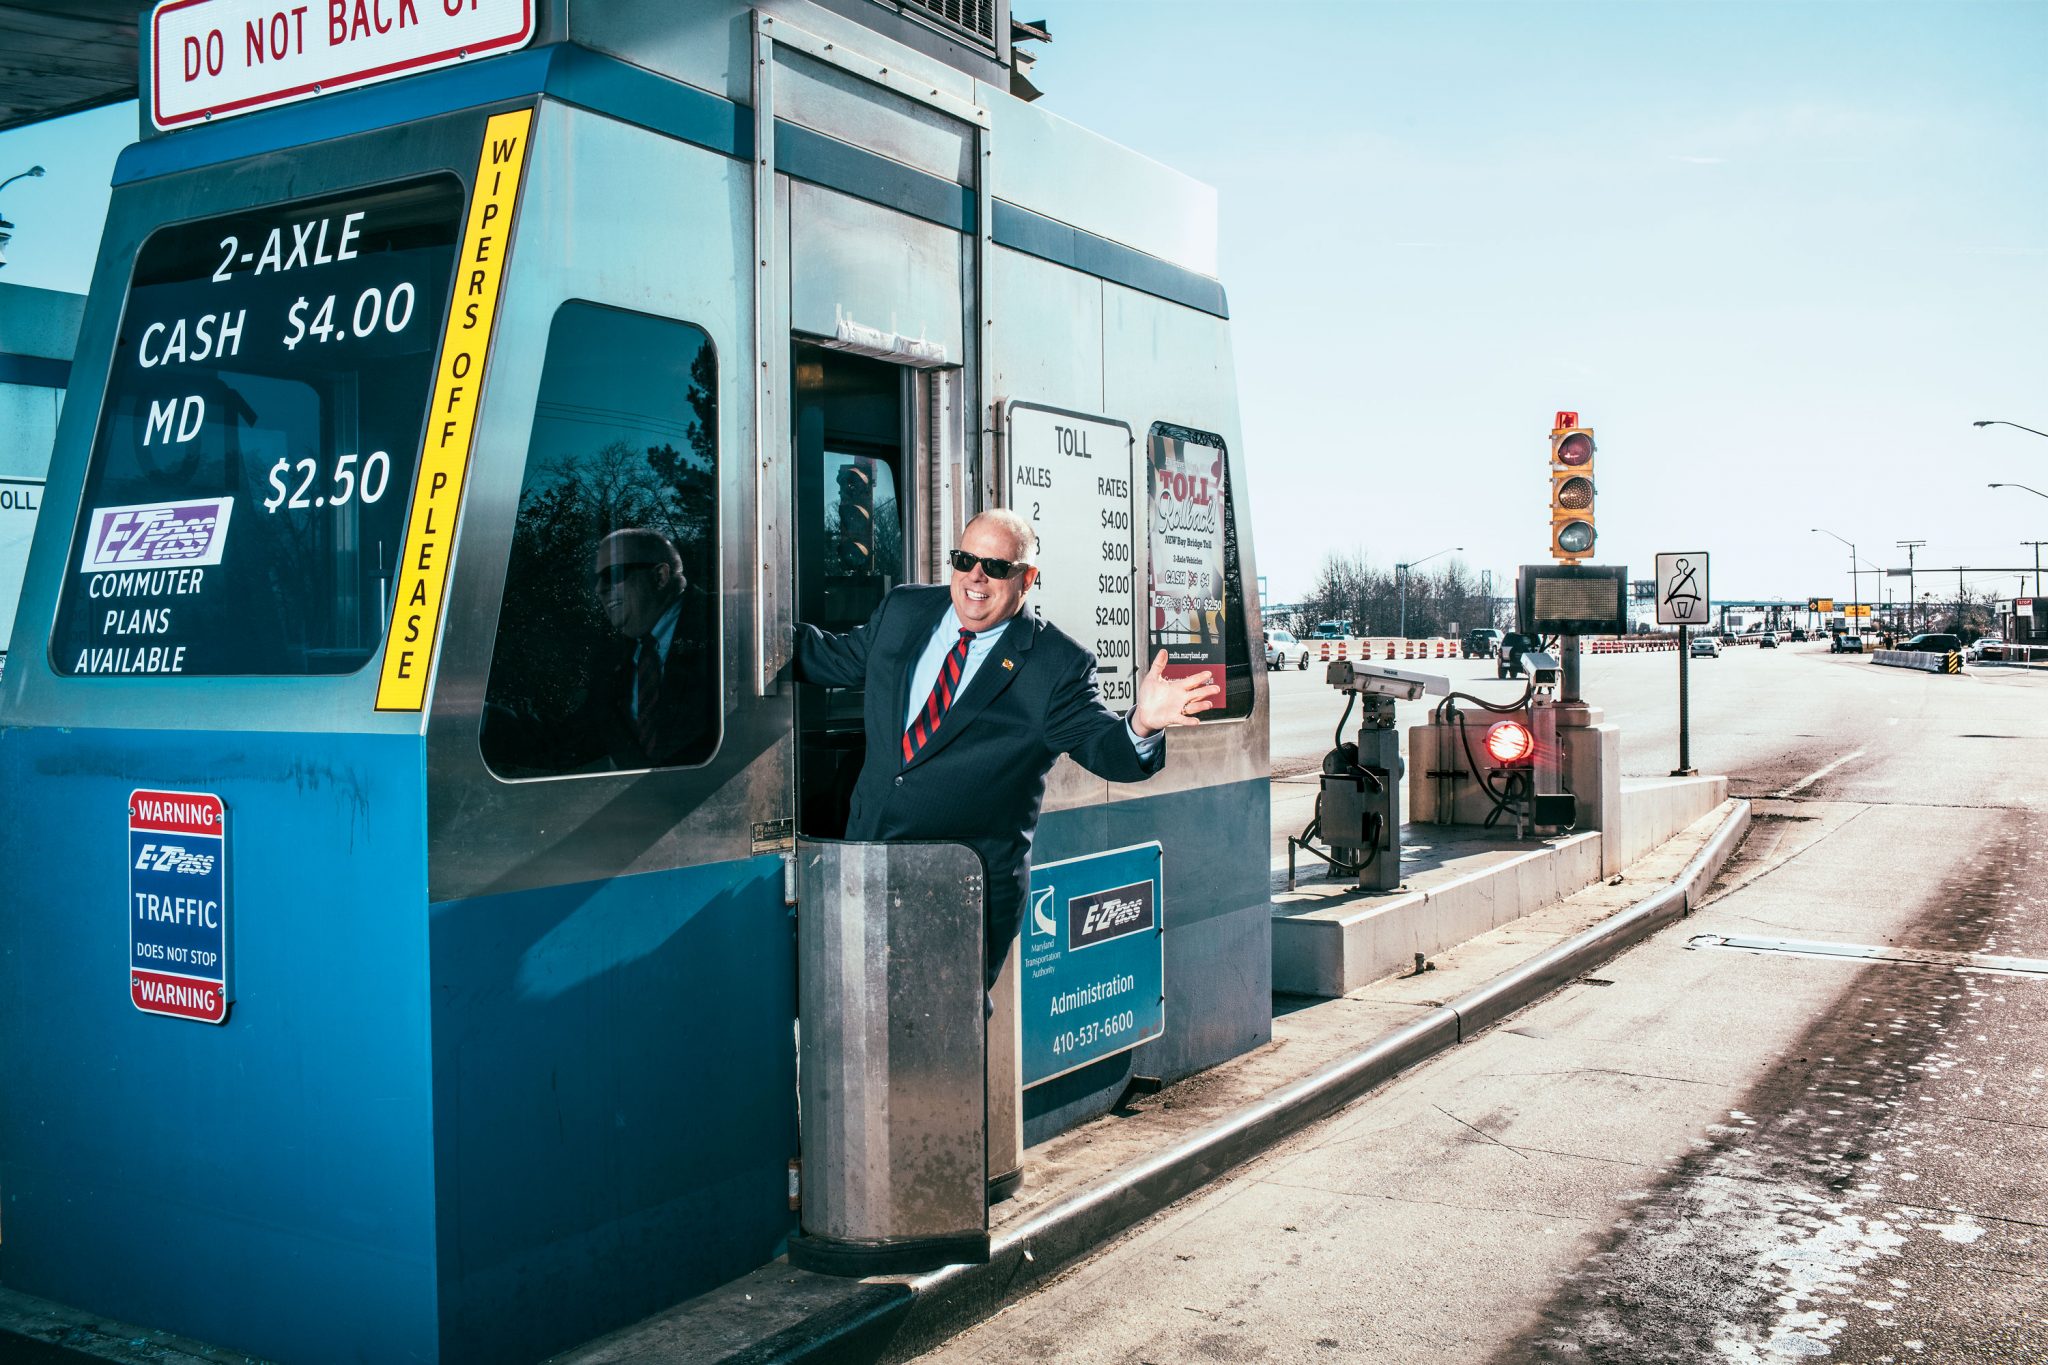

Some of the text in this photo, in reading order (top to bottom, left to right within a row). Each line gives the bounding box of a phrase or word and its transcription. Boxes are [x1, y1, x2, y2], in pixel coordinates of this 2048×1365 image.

[184, 0, 418, 82] DO NOT BACK
[212, 212, 365, 283] 2-AXLE
[139, 282, 415, 368] CASH $4.00
[143, 396, 205, 446] MD
[398, 137, 517, 679] WIPERS OFF PLEASE
[1055, 426, 1092, 458] TOLL
[264, 451, 390, 513] $2.50
[1017, 465, 1128, 499] AXLES RATES
[1160, 469, 1211, 506] TOLL
[1033, 502, 1128, 530] 2 $4.00
[1102, 541, 1128, 562] $8.00
[1165, 535, 1212, 550] NEW Bay Bridge Toll
[89, 569, 203, 598] COMMUTER
[1034, 571, 1129, 594] 4 $12.00
[1165, 570, 1186, 585] CASH
[1200, 572, 1209, 588] $4
[1096, 606, 1130, 627] $24.00
[1204, 597, 1222, 611] $2.50
[103, 608, 171, 635] PLANS
[74, 647, 186, 673] AVAILABLE
[1097, 639, 1130, 659] $30.00
[1103, 681, 1131, 701] $2.50
[138, 800, 213, 826] WARNING
[135, 844, 214, 876] E-ZPass
[136, 893, 217, 928] TRAFFIC
[1081, 899, 1143, 935] E-ZPass
[137, 942, 217, 967] DOES NOT STOP
[1025, 951, 1061, 968] Transportation
[1031, 939, 1055, 952] Maryland
[1032, 965, 1055, 979] Authority
[140, 981, 215, 1011] WARNING
[1050, 974, 1134, 1016] Administration
[1052, 1010, 1134, 1055] 410-537-6600
